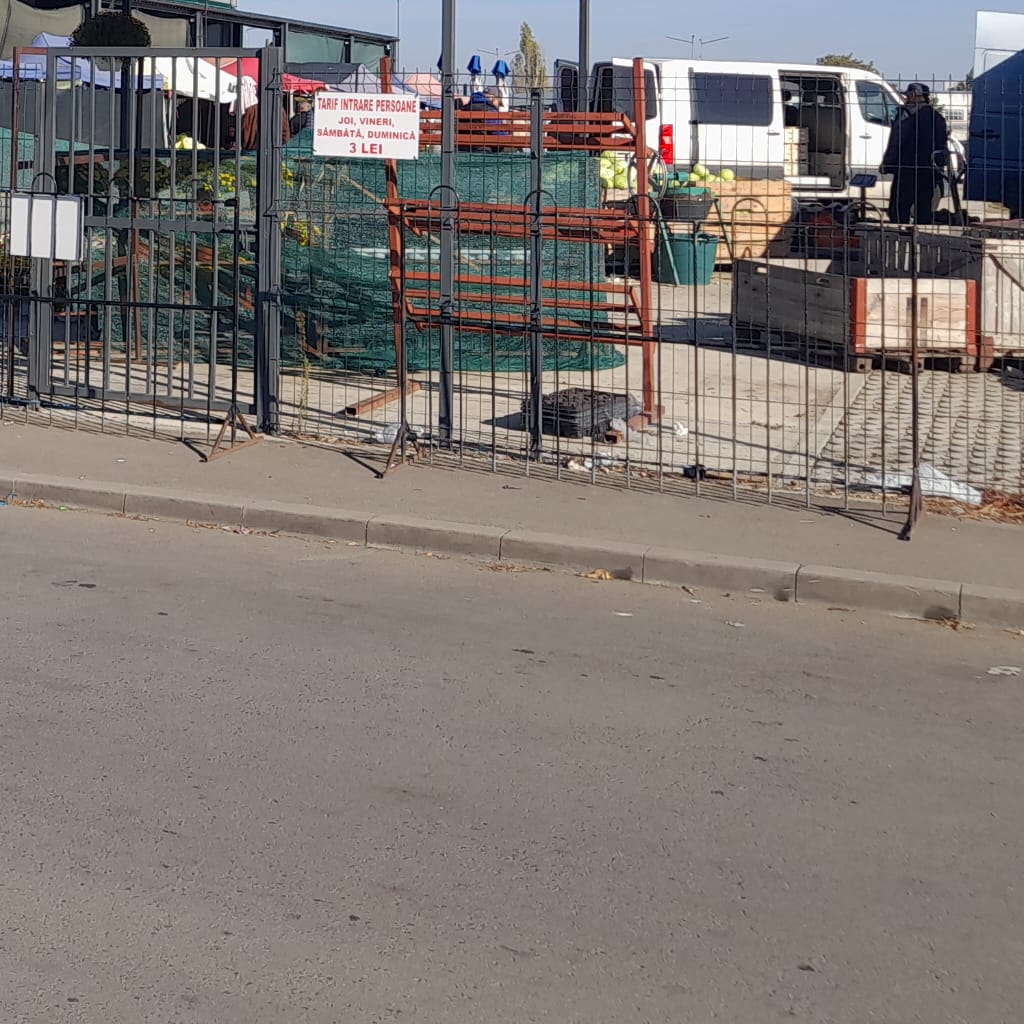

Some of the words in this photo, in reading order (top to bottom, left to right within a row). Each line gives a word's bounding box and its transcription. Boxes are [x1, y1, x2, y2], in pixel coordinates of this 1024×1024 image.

[317, 98, 338, 110] TARIF
[340, 98, 374, 112] INTRARE
[376, 100, 417, 113] PERSOANE
[338, 117, 357, 126] JOI,
[359, 117, 395, 128] VINERI,
[349, 142, 357, 154] 3
[361, 143, 383, 154] LEI
